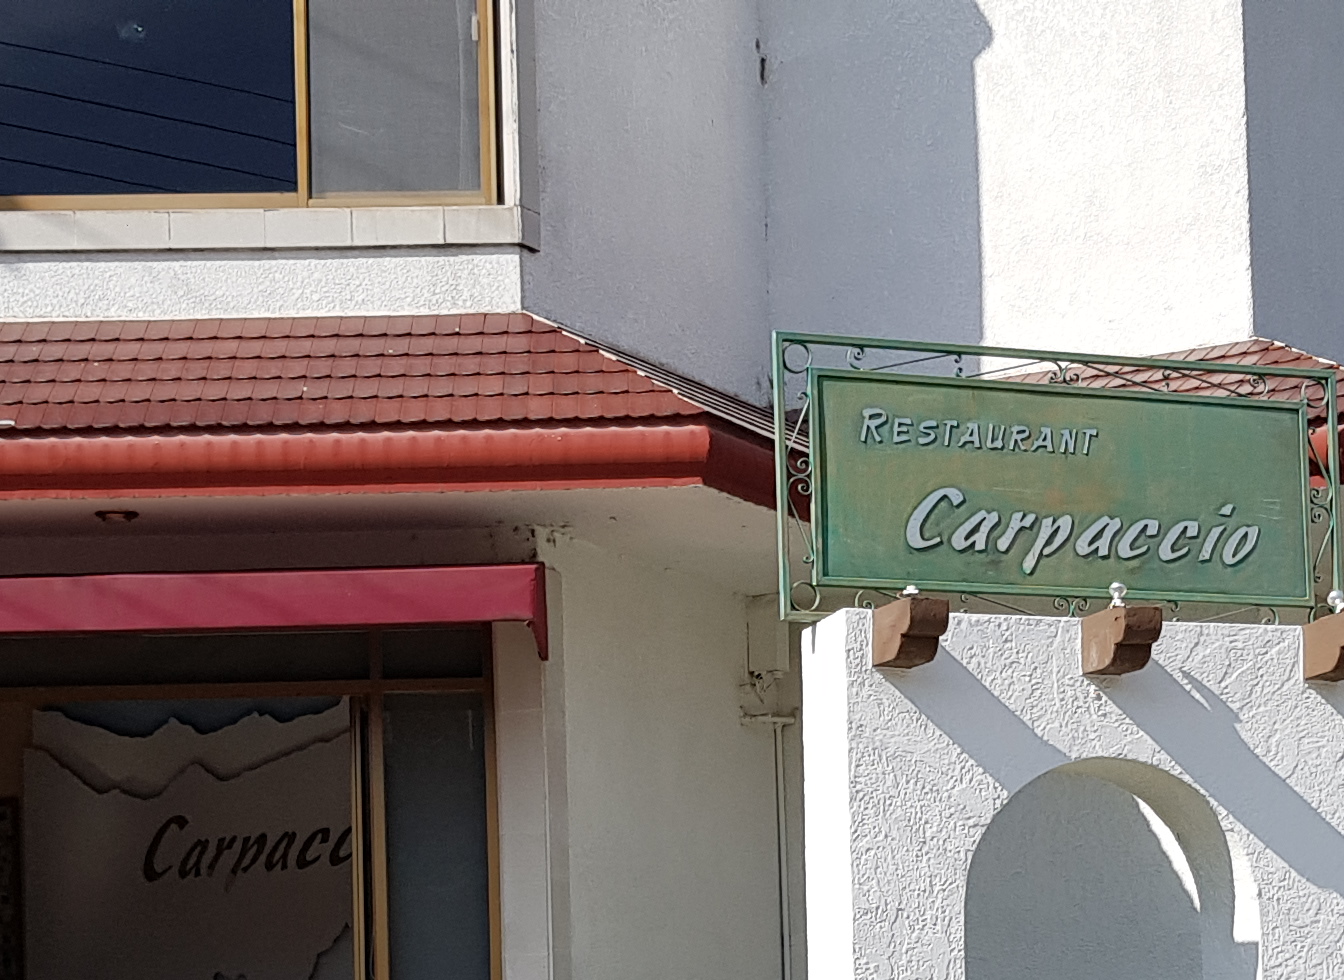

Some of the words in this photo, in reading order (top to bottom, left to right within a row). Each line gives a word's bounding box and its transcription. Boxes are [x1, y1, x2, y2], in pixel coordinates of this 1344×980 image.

[859, 407, 1099, 457] RESTAURANT
[904, 486, 1261, 576] Carpaccio
[143, 814, 353, 894] Carpacc
